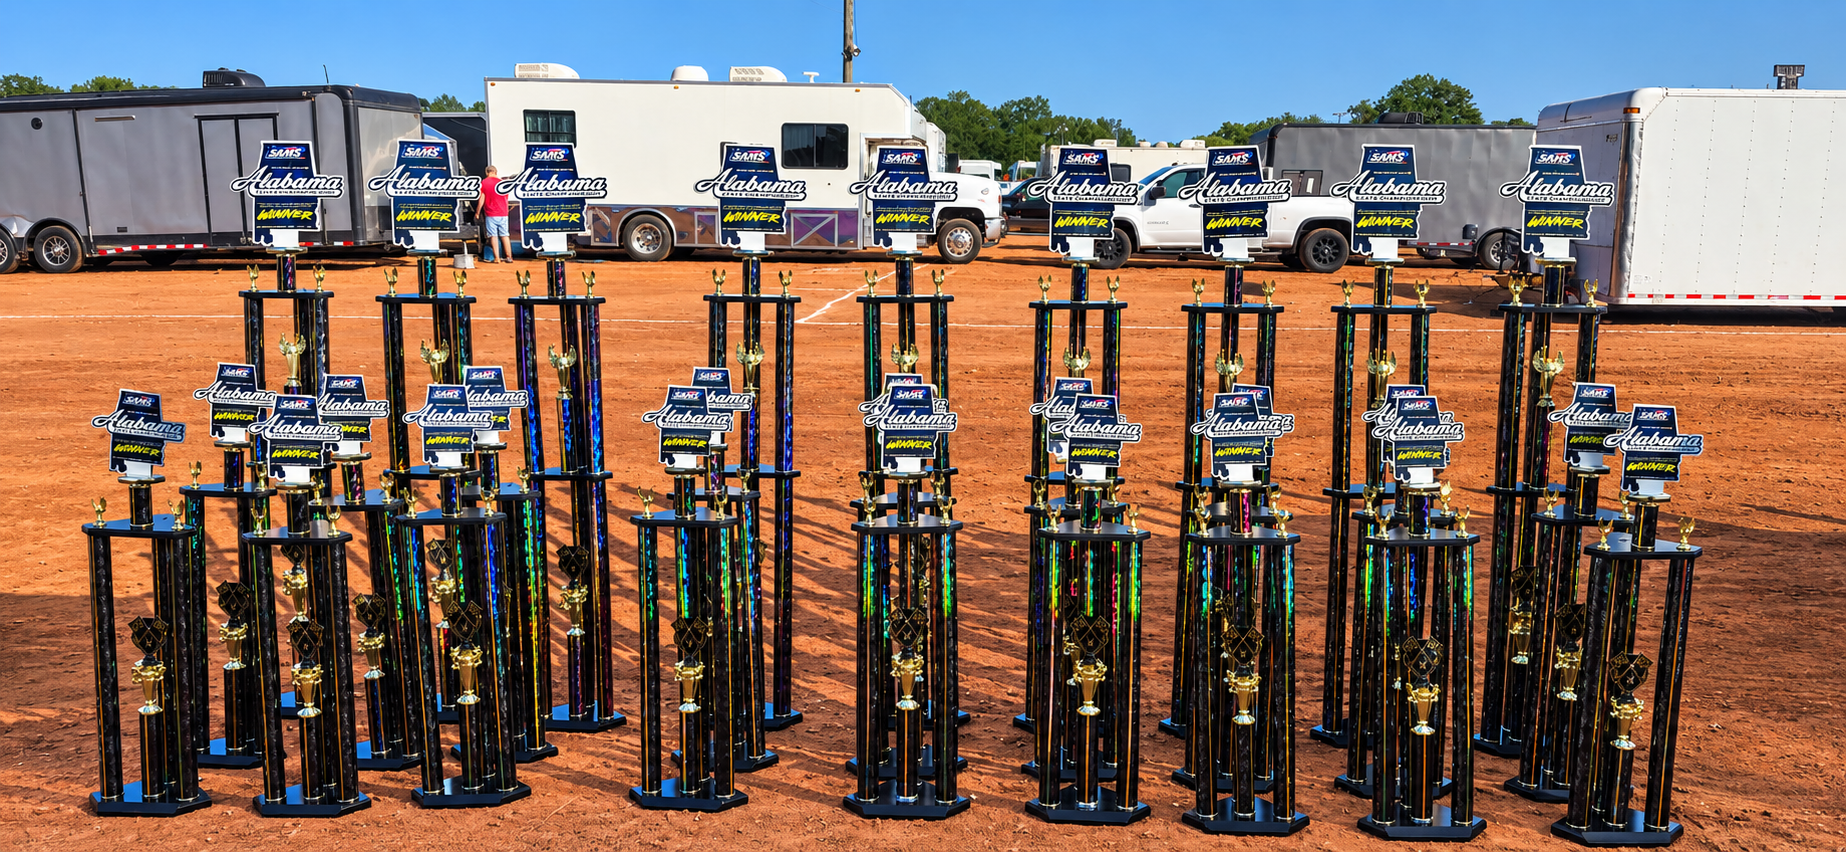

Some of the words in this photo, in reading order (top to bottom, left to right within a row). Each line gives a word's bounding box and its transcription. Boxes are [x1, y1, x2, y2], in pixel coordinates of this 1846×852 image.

[232, 165, 341, 191] Alabama
[369, 165, 481, 191] Alabama
[497, 167, 605, 194] Alabama
[697, 168, 804, 193] Alabama
[851, 170, 956, 195] Alabama
[1028, 171, 1136, 197] Alabama
[1180, 172, 1290, 198] Alabama
[1333, 171, 1445, 197] Alabama
[1501, 170, 1613, 196] Alabama
[256, 210, 314, 221] WINNER
[395, 209, 453, 222] WINNER
[524, 211, 576, 225] WINNER
[722, 211, 781, 224] WINNER
[875, 212, 930, 224] WINNER
[1054, 215, 1109, 228] WINNER
[1205, 216, 1262, 230] WINNER
[1356, 215, 1414, 229] WINNER
[1526, 215, 1583, 228] WINNER
[466, 385, 526, 401] labama
[708, 391, 751, 404] bama
[93, 409, 182, 433] Alabama
[404, 403, 490, 422] Alabama
[643, 404, 730, 425] Alabama
[864, 404, 955, 424] Alabama
[1192, 412, 1280, 431] Alabama
[250, 413, 340, 435] Alabama
[1051, 413, 1141, 435] Alabama
[1373, 416, 1463, 435] Alabama
[1606, 425, 1702, 446] Alabama
